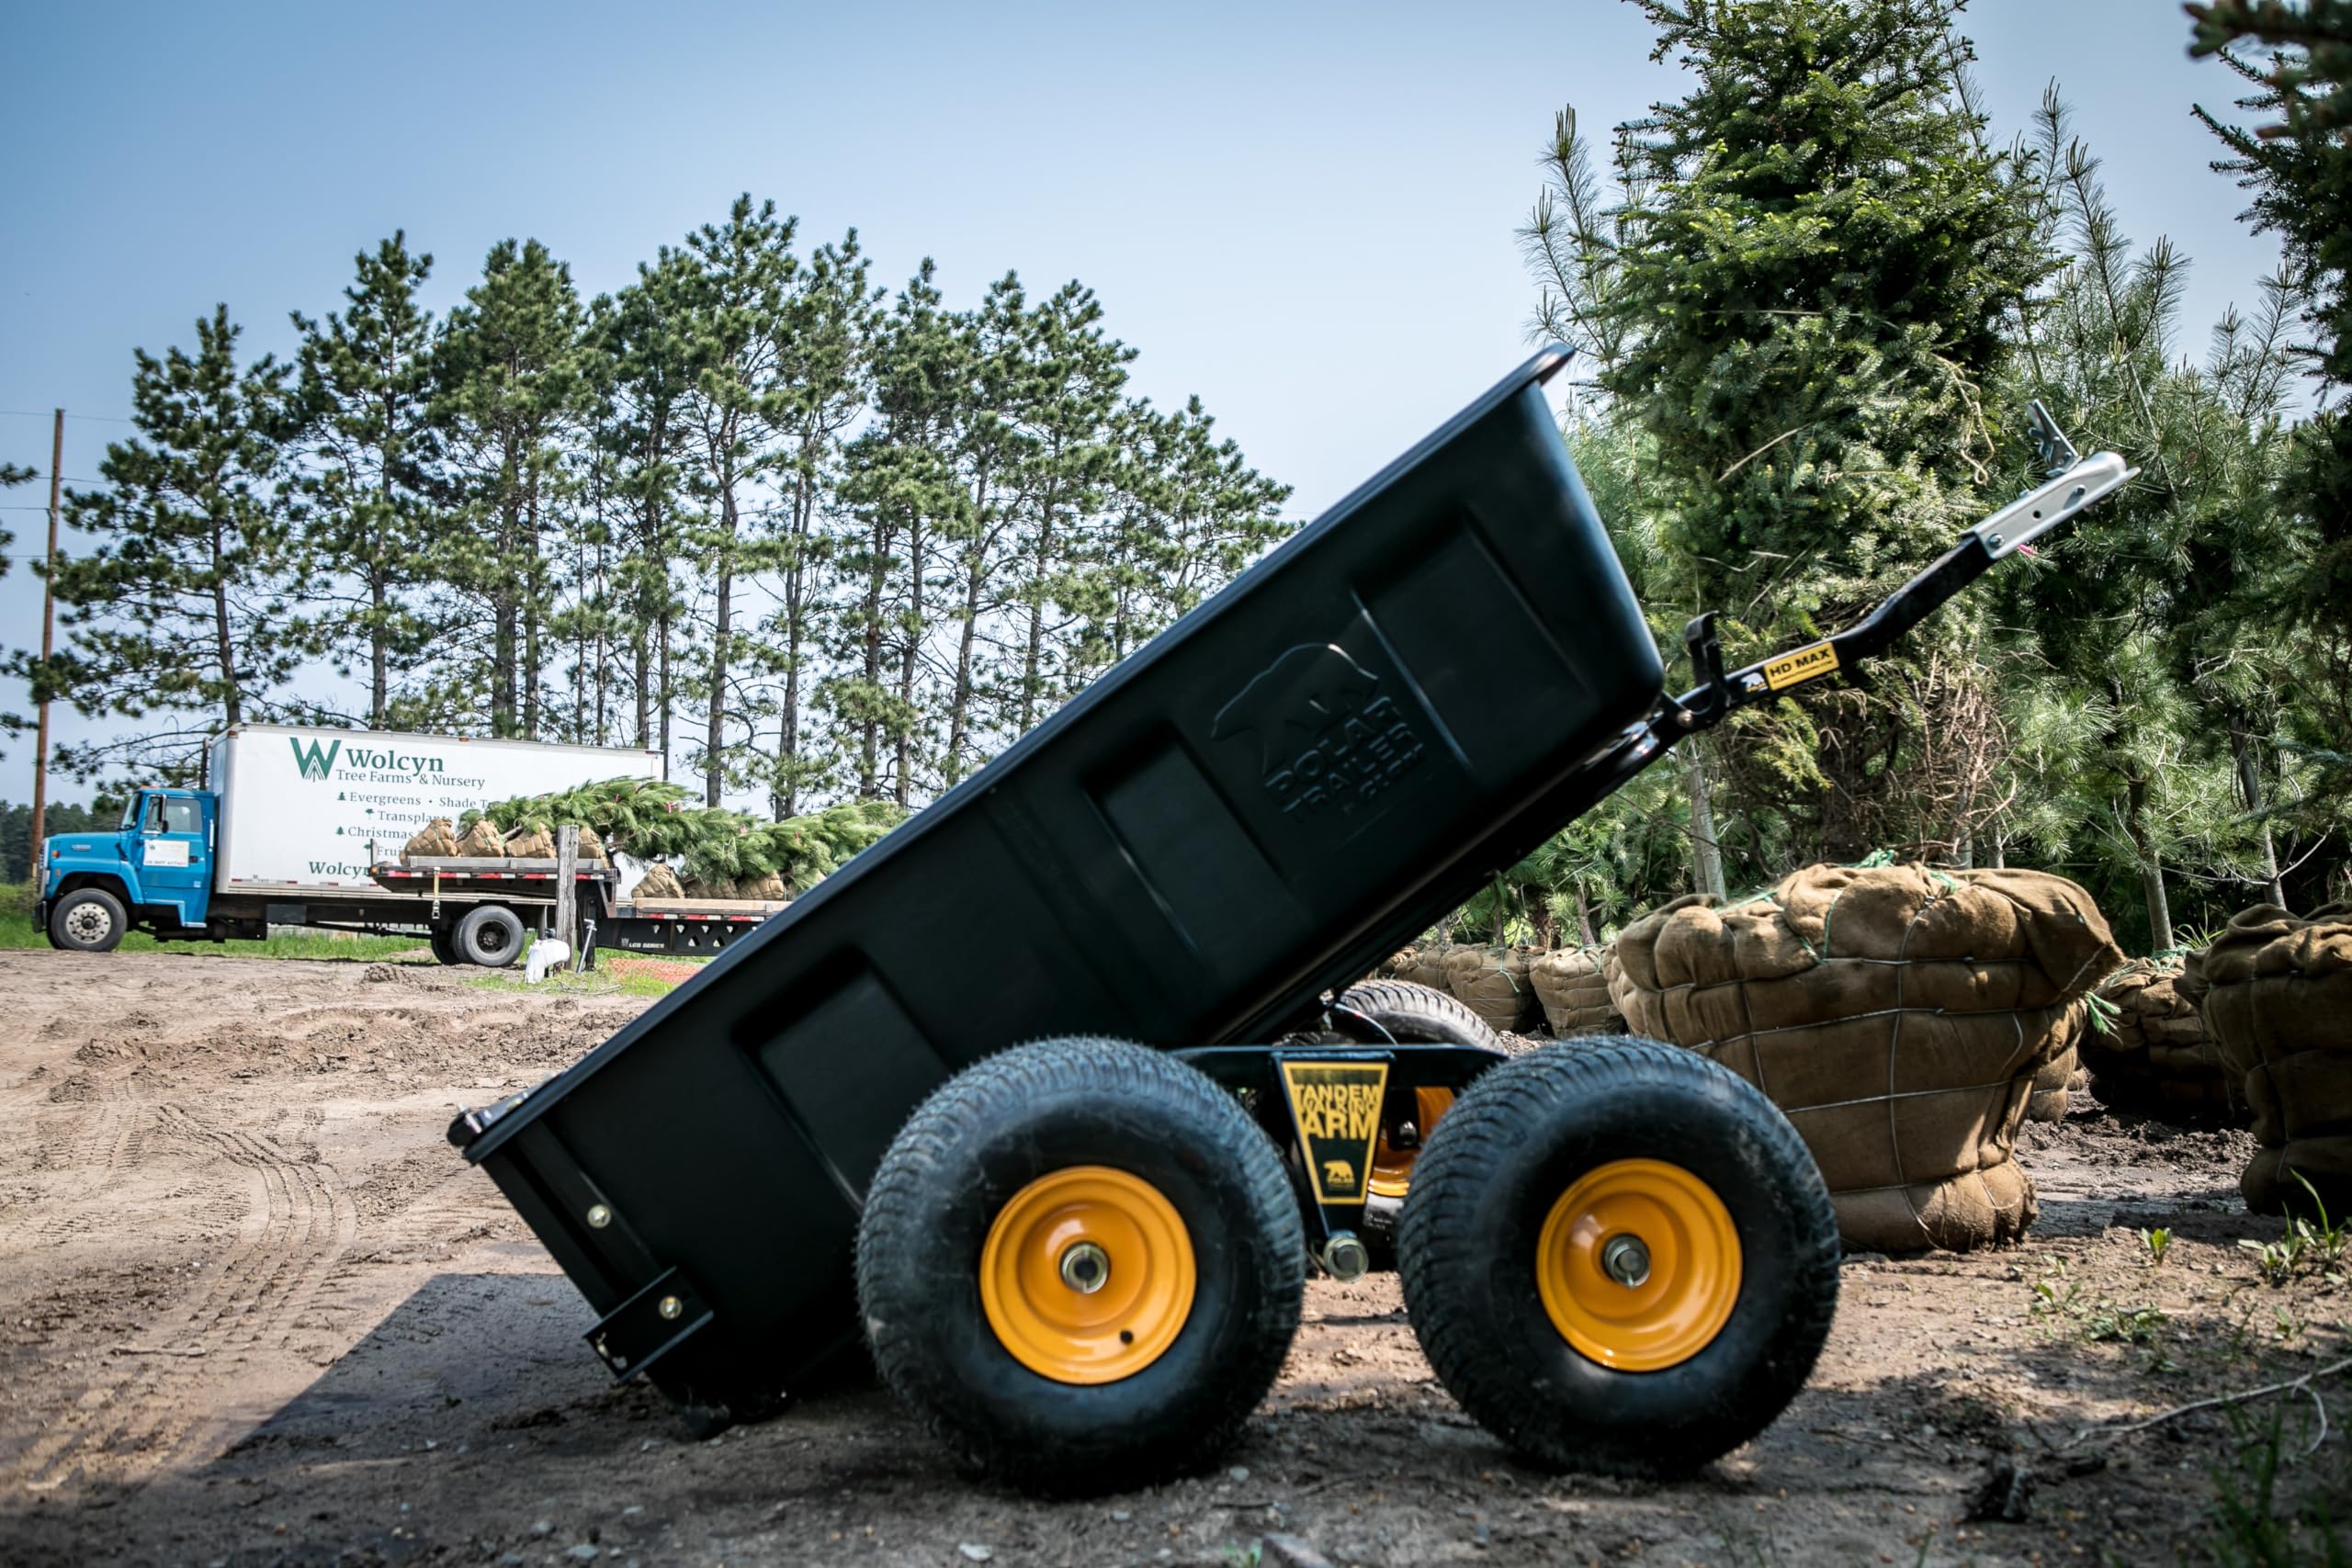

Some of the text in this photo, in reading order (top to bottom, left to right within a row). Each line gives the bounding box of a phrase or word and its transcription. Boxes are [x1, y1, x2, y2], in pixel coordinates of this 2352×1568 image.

[1770, 663, 1792, 675] HD
[1795, 649, 1831, 668] MAX
[345, 748, 444, 776] Wolcyn
[336, 769, 485, 790] Tree Farms & Nursery
[350, 792, 421, 806] Evergreens
[439, 796, 476, 808] Shade
[348, 826, 413, 839] Christmas
[1293, 1084, 1379, 1101] TANDEM
[1306, 1110, 1373, 1139] ARM
